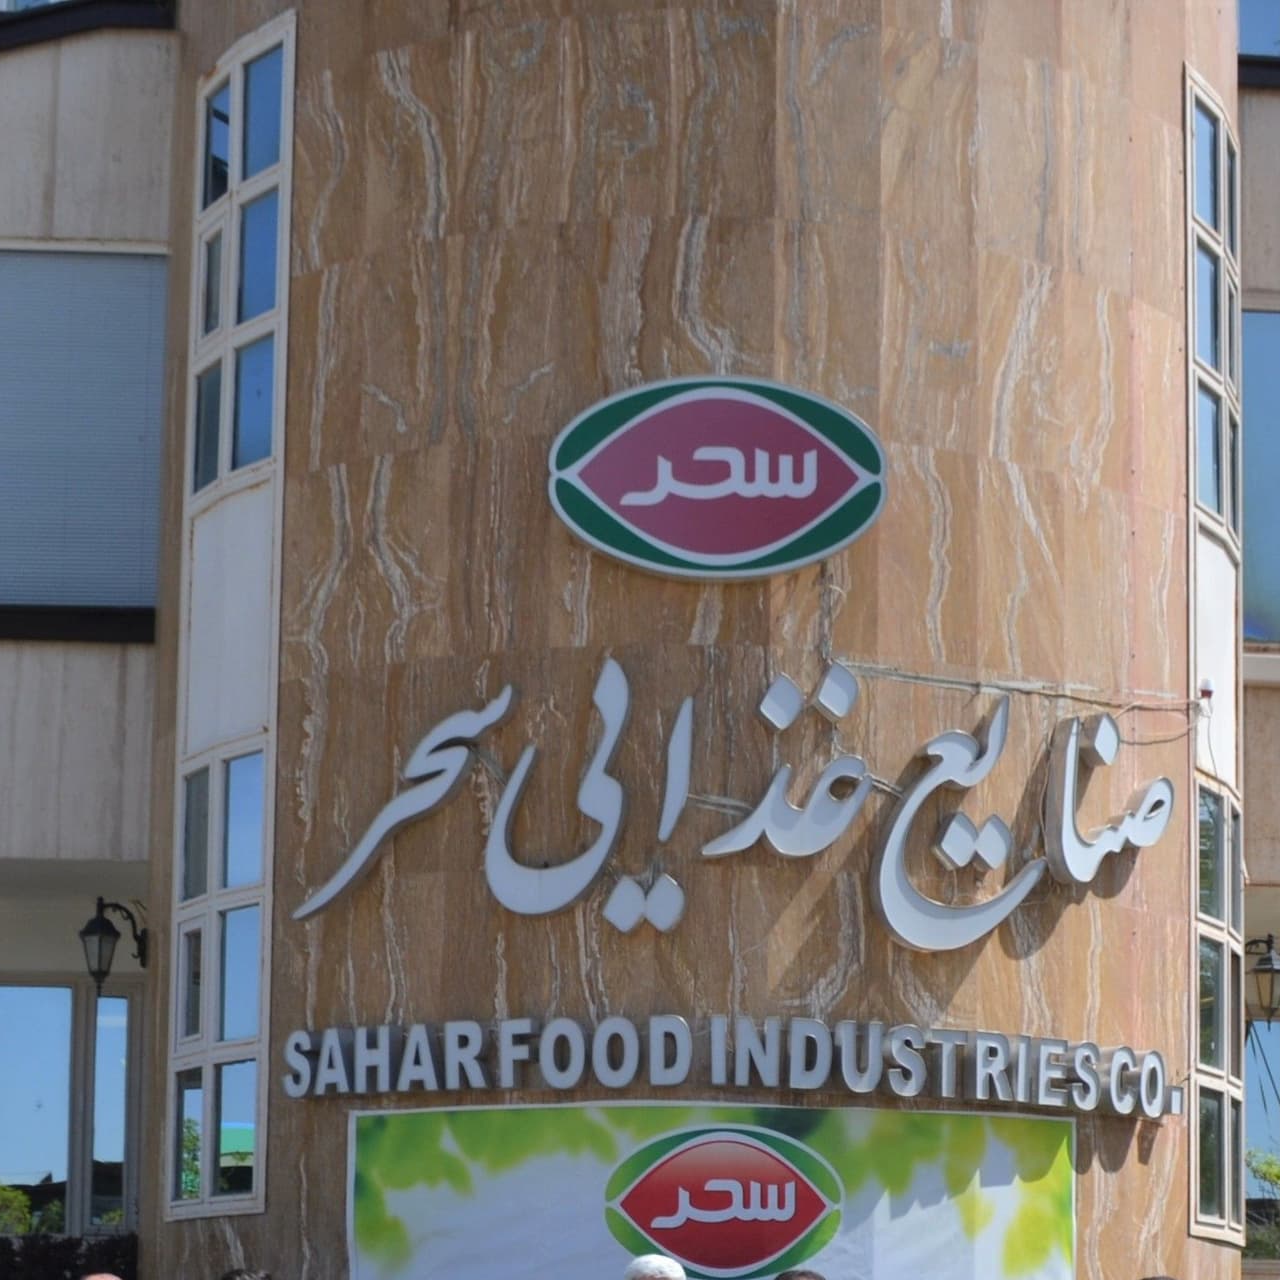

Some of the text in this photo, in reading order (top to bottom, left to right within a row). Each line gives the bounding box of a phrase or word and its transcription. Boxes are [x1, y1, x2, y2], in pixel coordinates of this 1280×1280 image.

[619, 446, 818, 506] سحر
[291, 657, 1174, 951] صنایع غذایی سحر
[282, 1020, 487, 1098] SAHAR
[497, 1014, 693, 1089] FOOD
[710, 1015, 1100, 1112] INDUSTRIES
[650, 1179, 796, 1229] سحر
